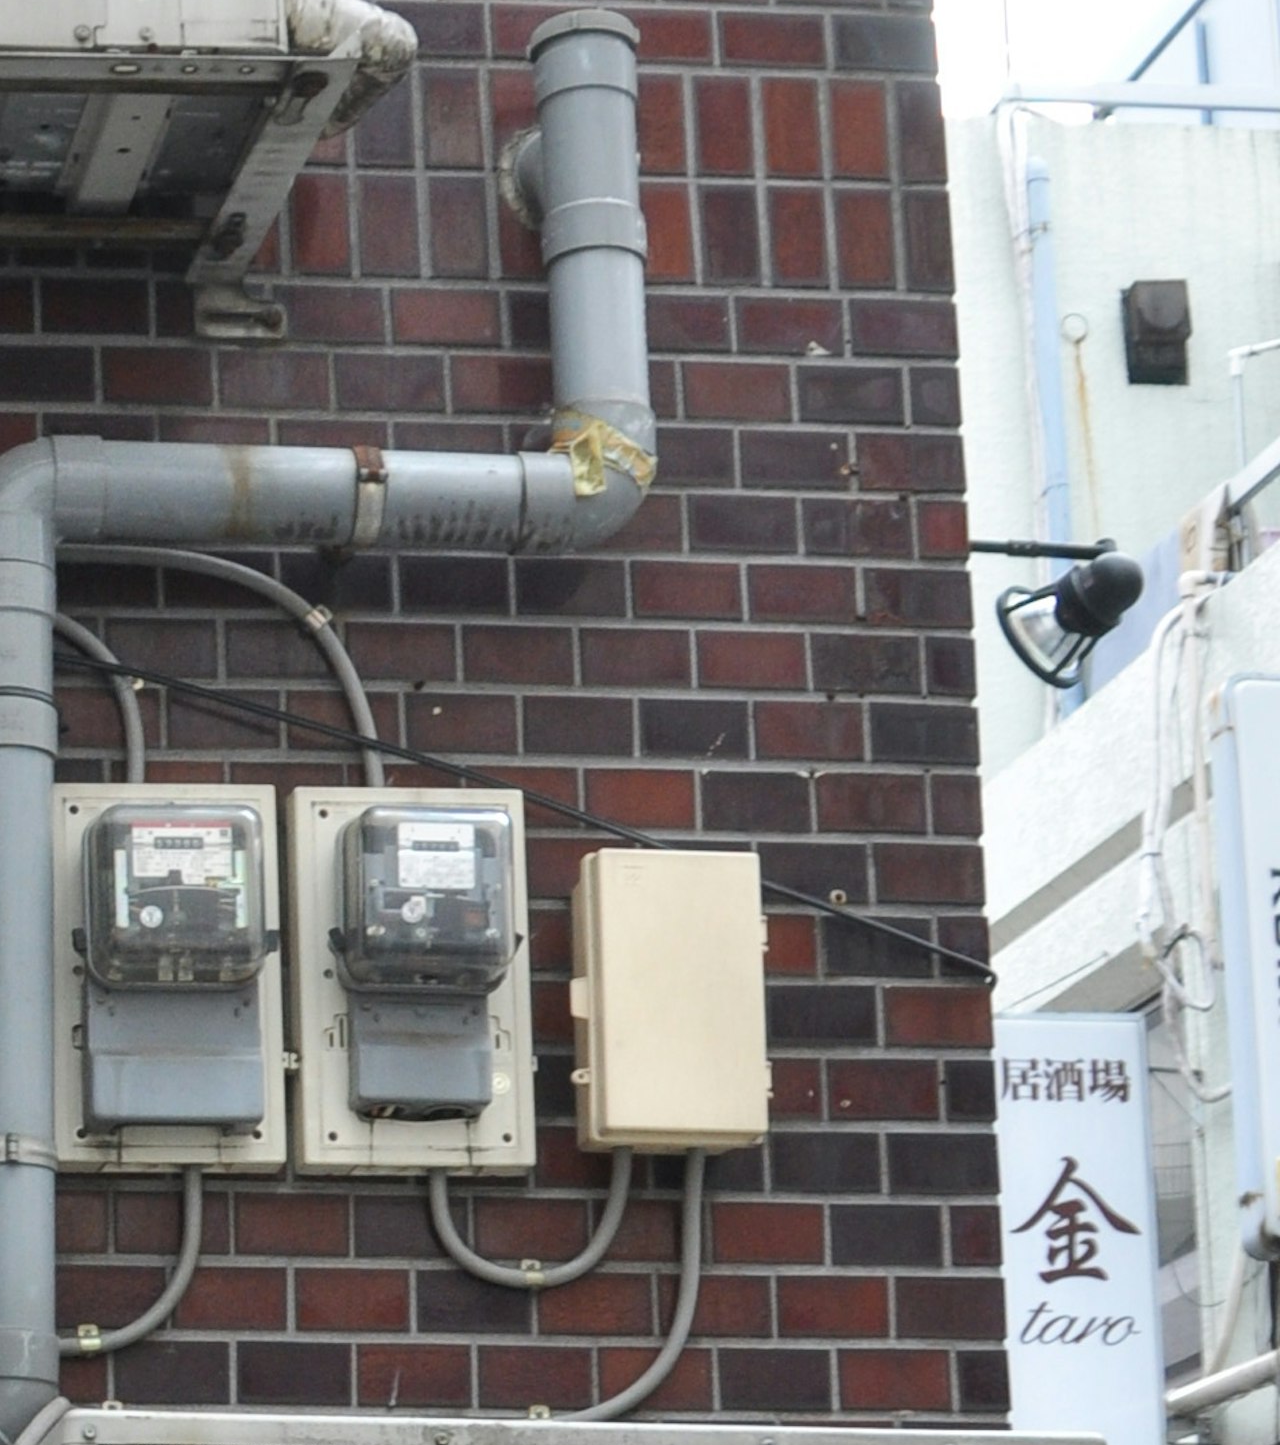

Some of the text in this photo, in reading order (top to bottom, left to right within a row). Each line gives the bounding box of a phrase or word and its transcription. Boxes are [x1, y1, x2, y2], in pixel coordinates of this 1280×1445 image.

[1000, 1057, 1132, 1104] 居酒場
[1009, 1155, 1142, 1285] 金
[1019, 1300, 1142, 1346] taro
